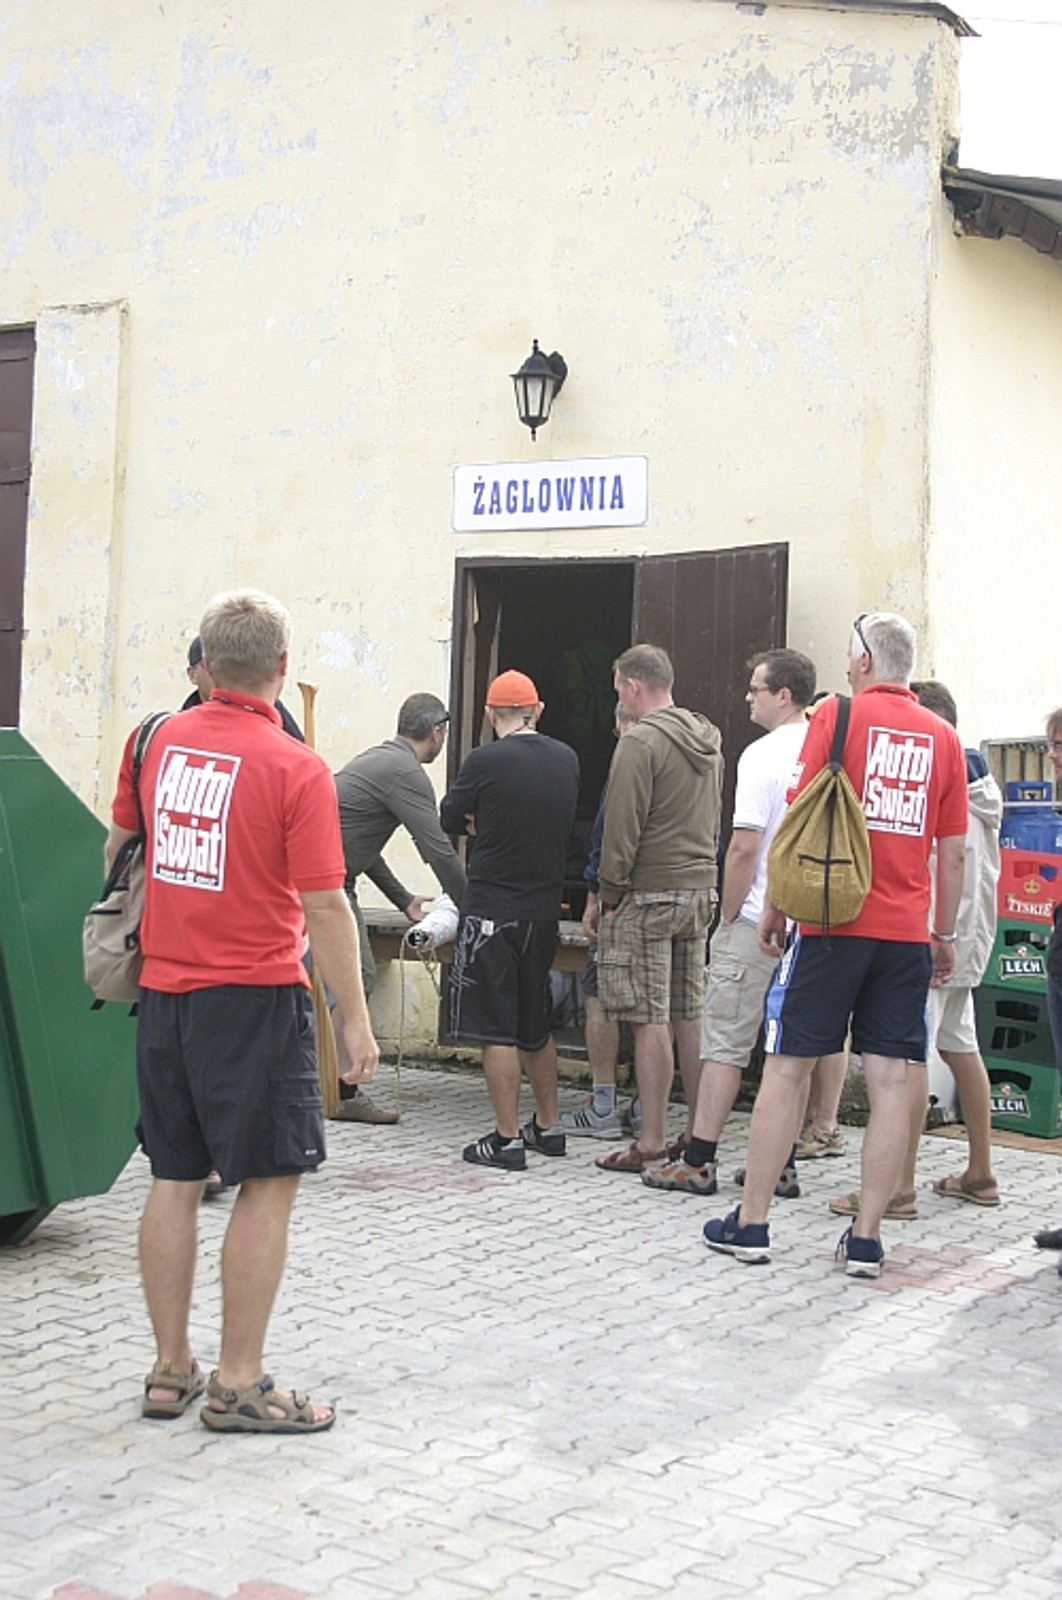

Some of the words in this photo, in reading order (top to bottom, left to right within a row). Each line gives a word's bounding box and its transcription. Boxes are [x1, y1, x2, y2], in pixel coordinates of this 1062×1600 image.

[473, 475, 625, 516] ŻAGLOWNIA
[867, 733, 930, 783] Auto
[156, 753, 232, 820] Auto
[1007, 895, 1054, 918] TYSKIE
[1005, 958, 1042, 975] LECH
